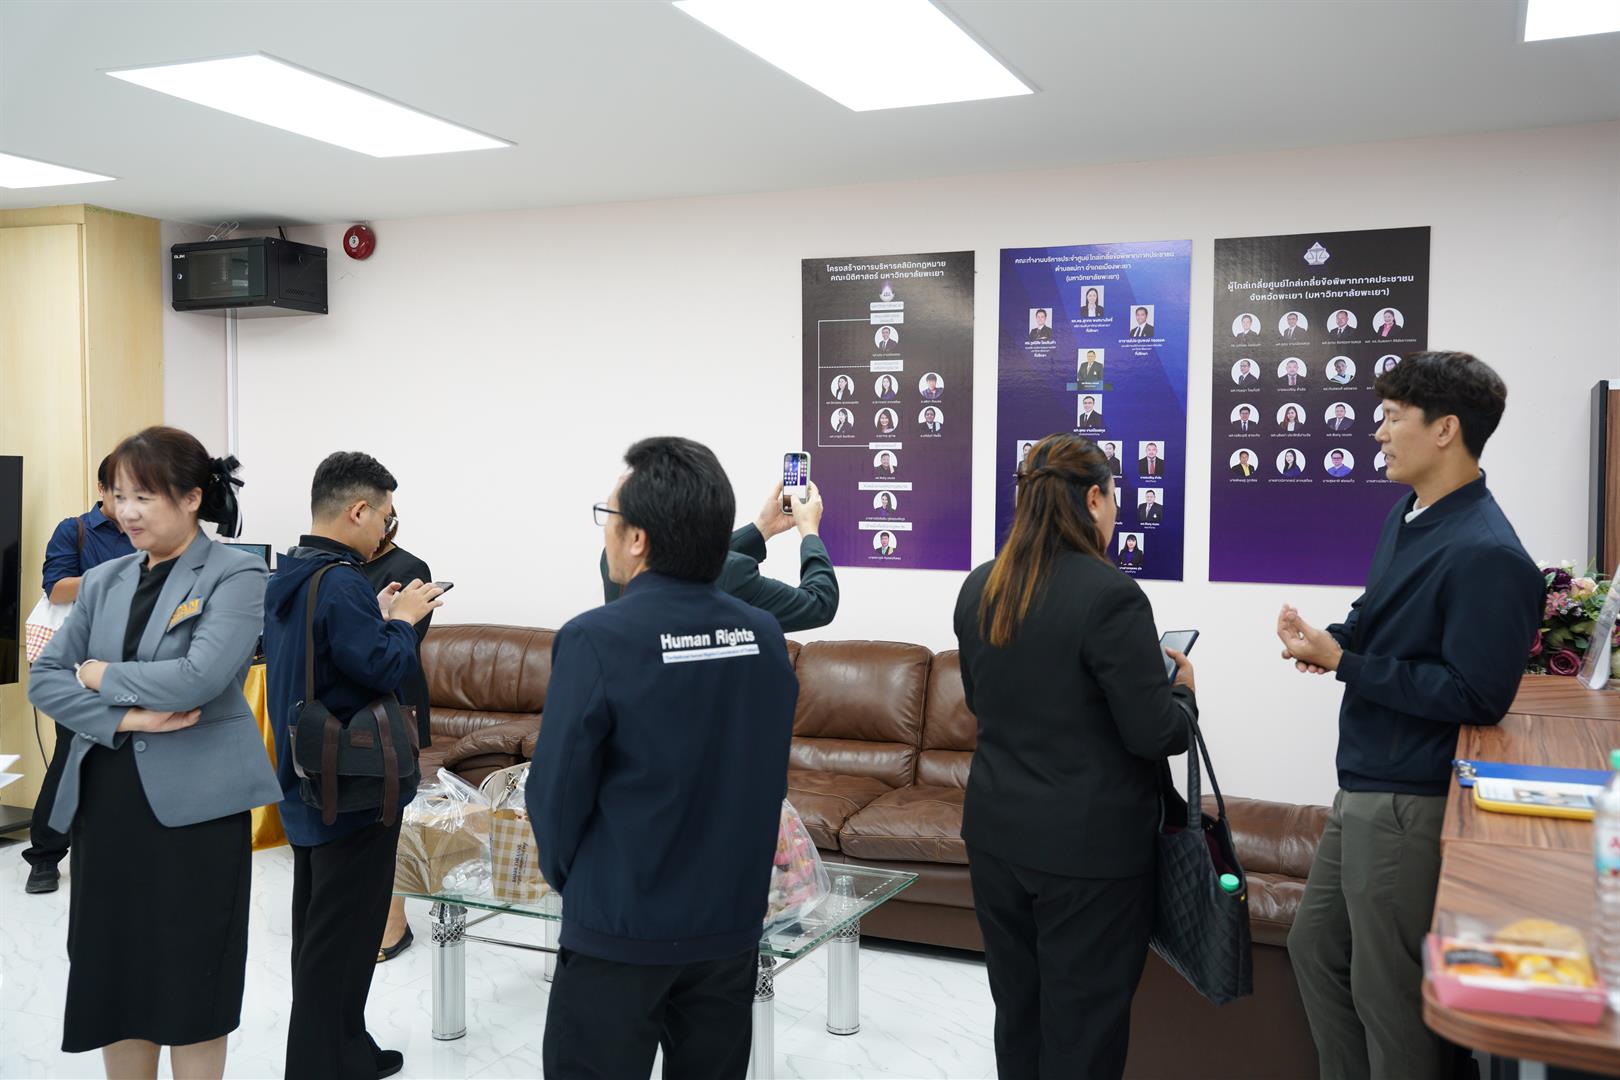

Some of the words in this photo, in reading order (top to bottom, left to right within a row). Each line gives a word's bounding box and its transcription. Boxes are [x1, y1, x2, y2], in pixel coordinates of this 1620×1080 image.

[830, 272, 879, 281] คณะนิติศาสตร์
[880, 270, 945, 280] มหาวิทยาลัยพะเยา
[1227, 275, 1415, 292] ผู้ไกล่เกลี่ยศูนย์ไกล่เกลี่ยข้อพิพาทภาคประชาชน
[1249, 291, 1304, 303] จังหวัดพะเยา
[1304, 287, 1391, 301] (มหาวิทยาลัยพะเยา)
[660, 633, 711, 650] Human
[715, 628, 756, 646] Rights
